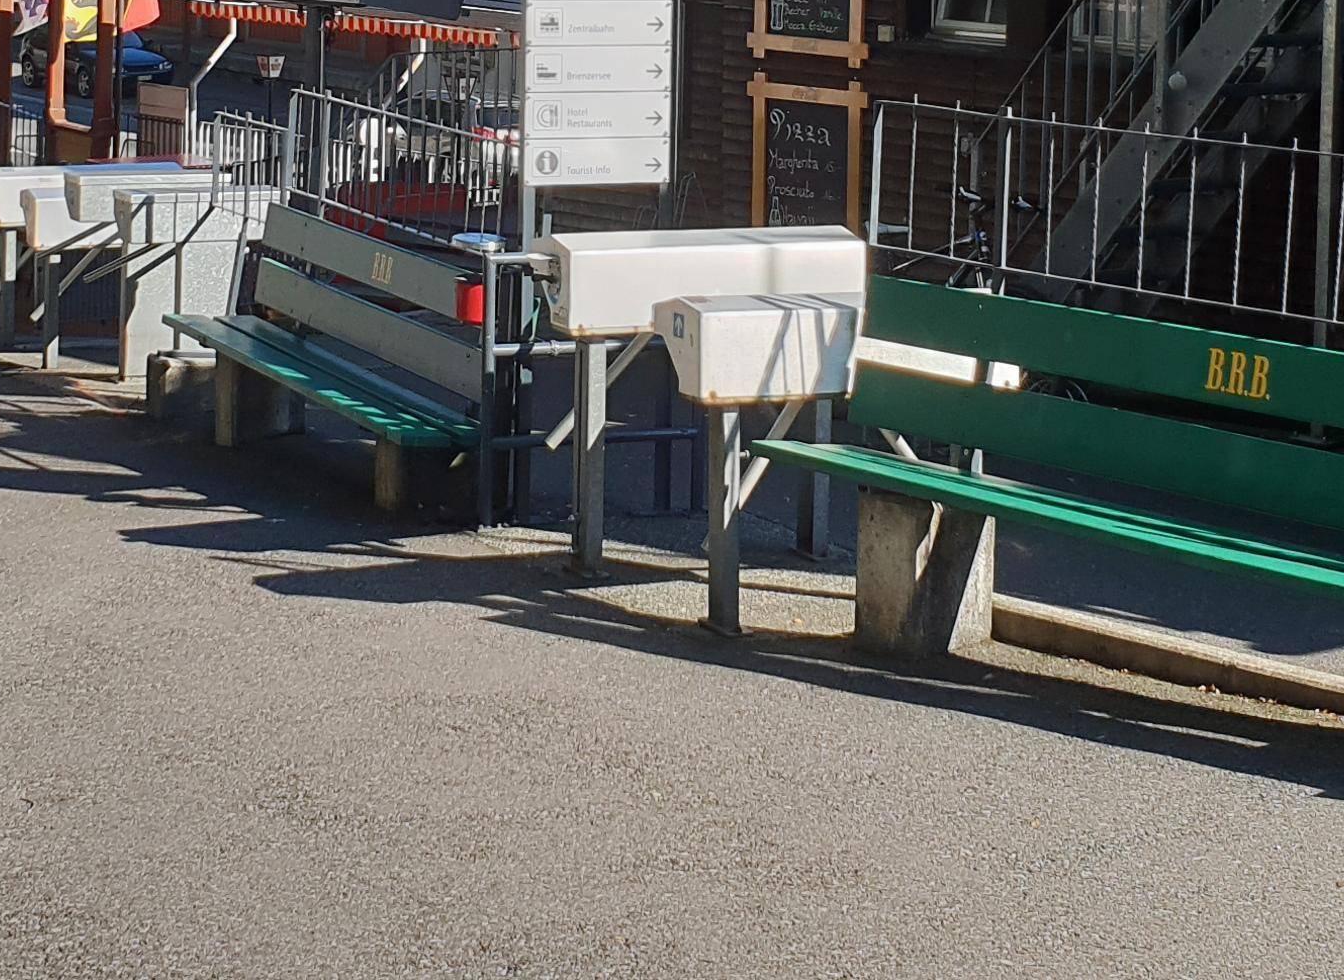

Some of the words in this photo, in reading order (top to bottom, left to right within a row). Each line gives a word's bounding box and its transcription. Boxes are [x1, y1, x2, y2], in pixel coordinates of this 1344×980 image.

[567, 70, 612, 81] Brienzersee
[567, 107, 589, 117] Hotel
[567, 117, 613, 129] Restaurants
[769, 108, 832, 147] Pizza
[567, 164, 593, 176] Tourist
[1204, 347, 1271, 401] B.R.B.
